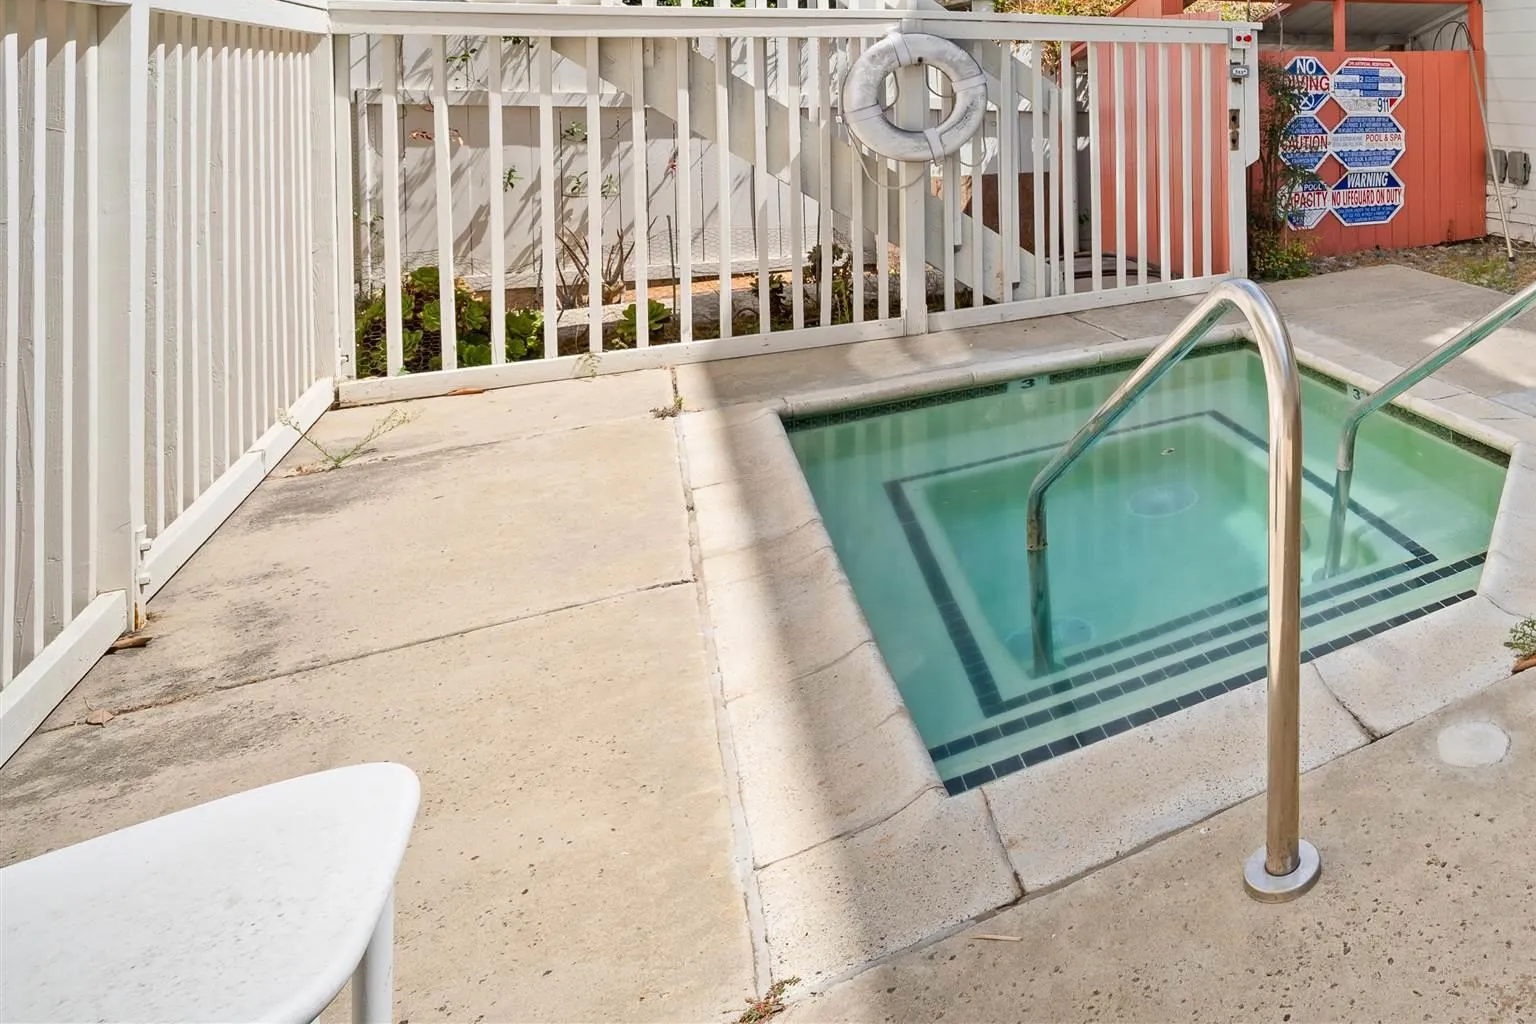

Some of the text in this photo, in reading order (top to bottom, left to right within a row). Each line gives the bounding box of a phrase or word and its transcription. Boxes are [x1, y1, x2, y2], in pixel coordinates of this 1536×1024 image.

[1296, 58, 1316, 74] NO
[1377, 98, 1389, 112] 911
[1365, 134, 1383, 142] POOL
[1384, 134, 1389, 142] &
[1389, 134, 1402, 142] SPA
[1347, 172, 1388, 188] WARNING
[1332, 188, 1402, 206] NO LIFEGUARD ON DUTY
[1020, 378, 1035, 389] 3
[1352, 388, 1361, 400] 3
